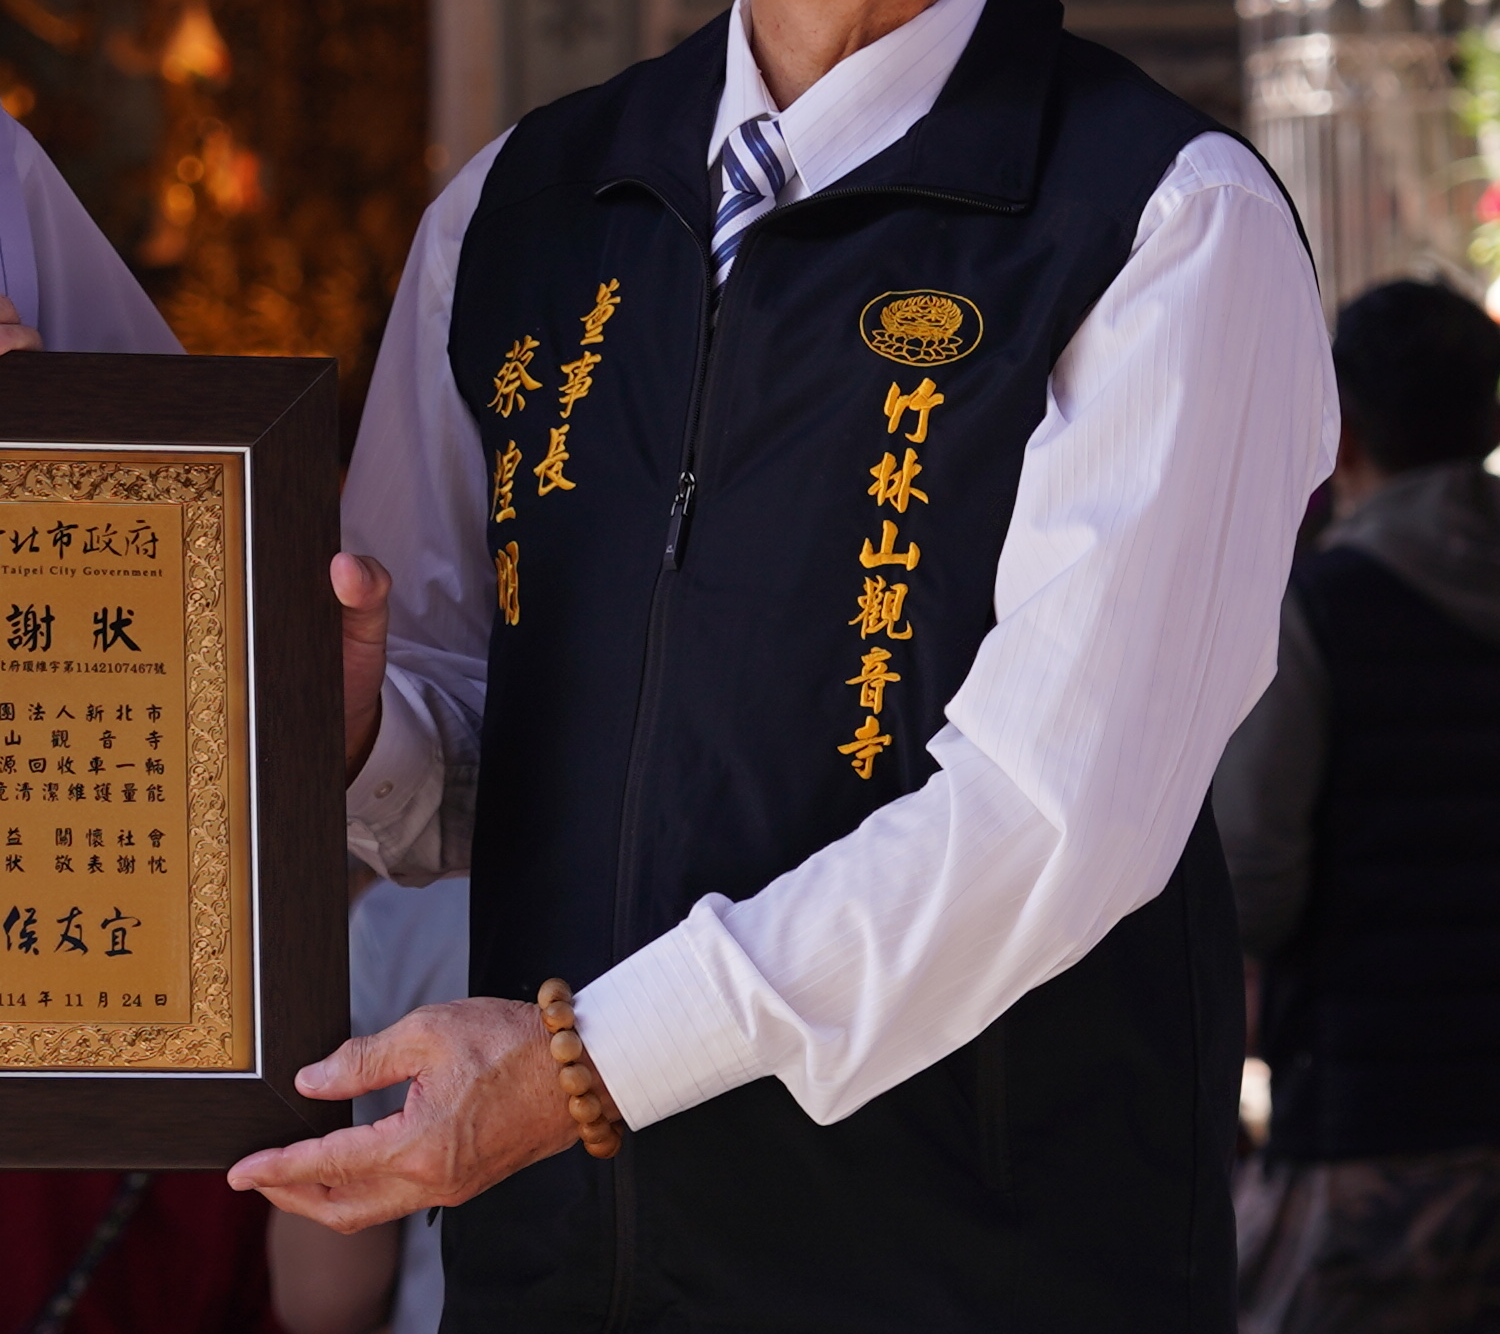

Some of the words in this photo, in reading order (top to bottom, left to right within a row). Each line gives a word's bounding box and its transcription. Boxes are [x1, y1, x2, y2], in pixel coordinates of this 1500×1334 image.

[529, 278, 621, 497] 董事長
[0, 564, 44, 578] Taipei
[48, 565, 77, 579] City
[82, 566, 163, 578] Government
[837, 377, 945, 780] 竹林山觀音寺
[54, 827, 166, 849] 關懷社會
[54, 853, 168, 875] 敬表謝忱
[2, 905, 142, 958] 侯友宜
[37, 990, 53, 1008] 年
[65, 993, 84, 1008] 11
[97, 990, 109, 1009] 月
[121, 992, 143, 1008] 24
[154, 993, 168, 1007] 日
